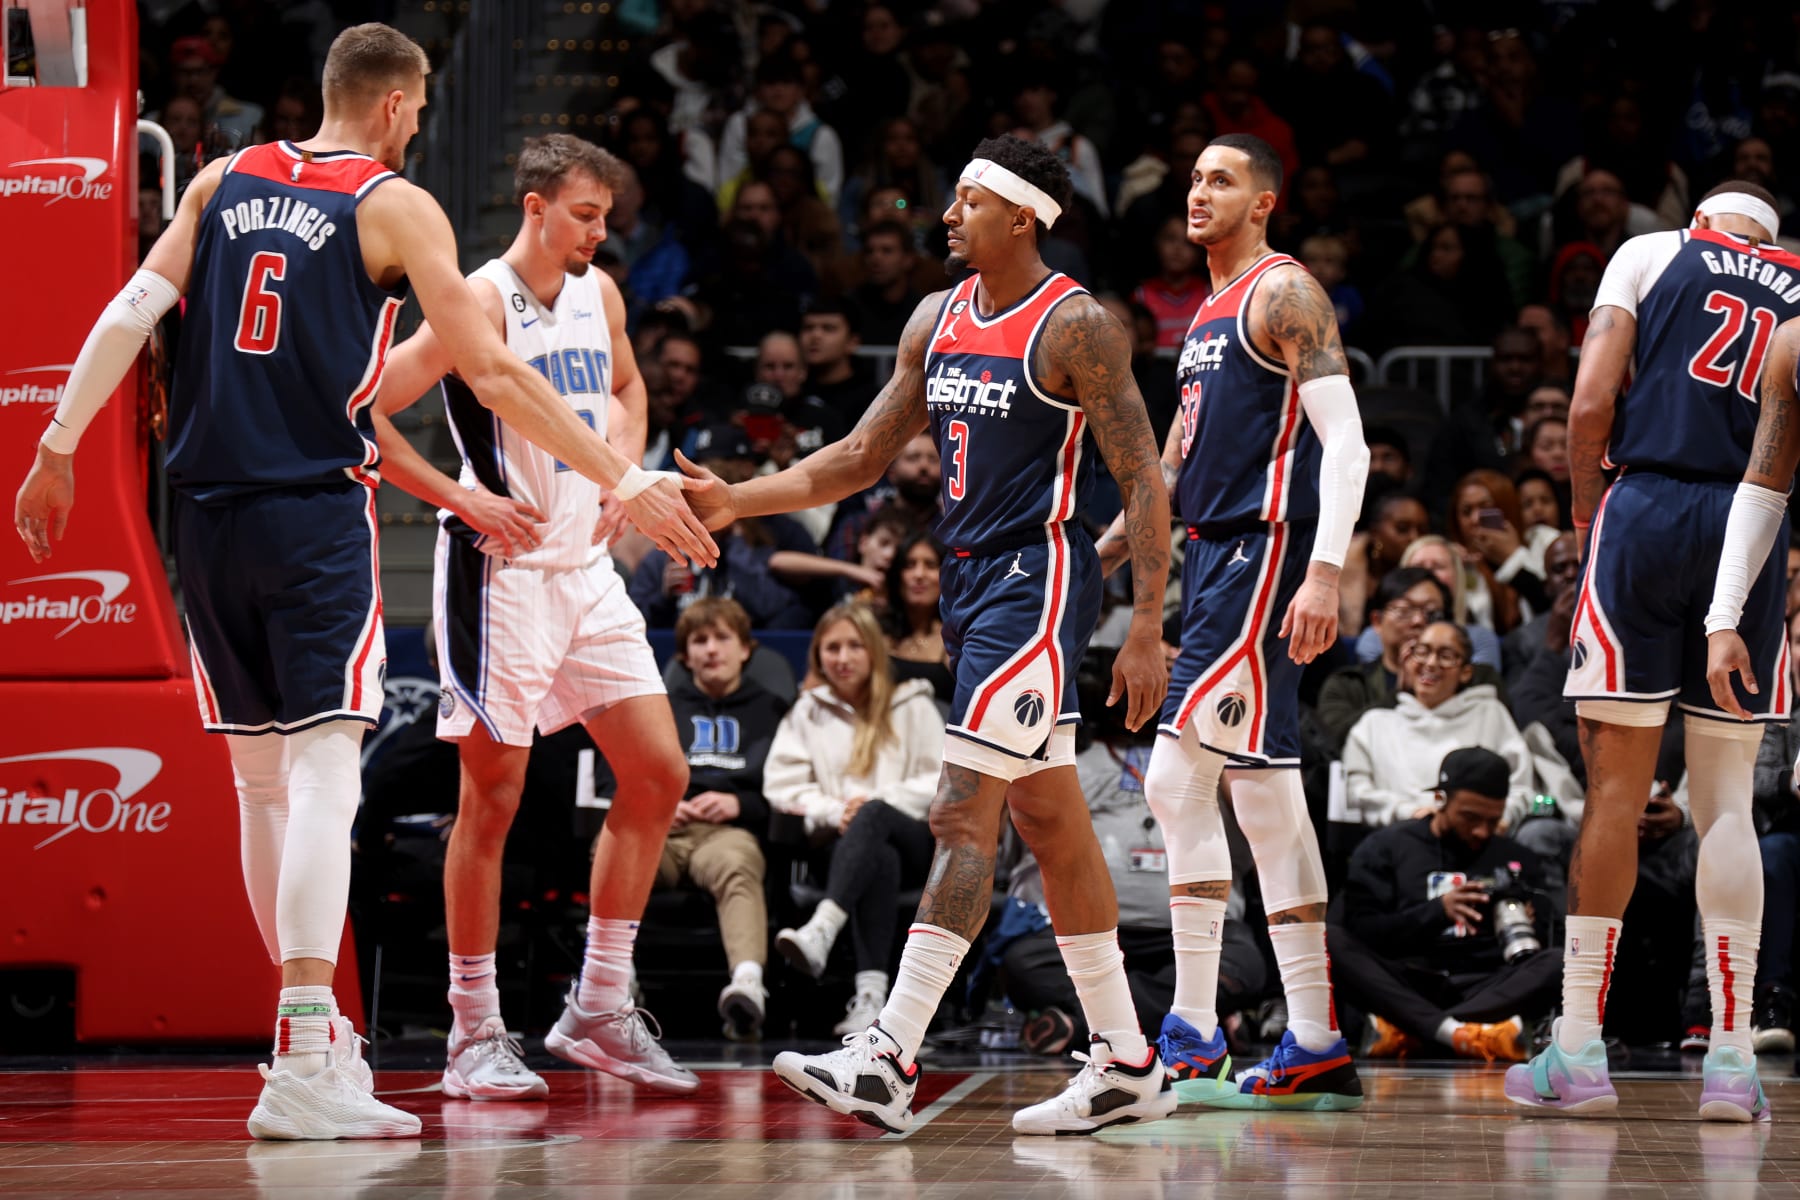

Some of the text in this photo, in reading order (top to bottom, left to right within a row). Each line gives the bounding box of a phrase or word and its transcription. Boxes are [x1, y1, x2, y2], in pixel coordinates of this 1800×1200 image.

[0, 175, 112, 199] pitalOne
[221, 197, 336, 251] PORZINGIS
[1701, 250, 1800, 304] GAFFORD
[234, 251, 287, 354] 6
[512, 293, 526, 313] 6
[952, 300, 967, 314] 6
[1688, 290, 1778, 403] 21
[0, 383, 65, 406] pital
[927, 362, 1017, 411] district
[947, 367, 962, 377] THE
[1182, 381, 1202, 459] 33
[949, 419, 969, 500] 3
[0, 595, 136, 624] pitalOne
